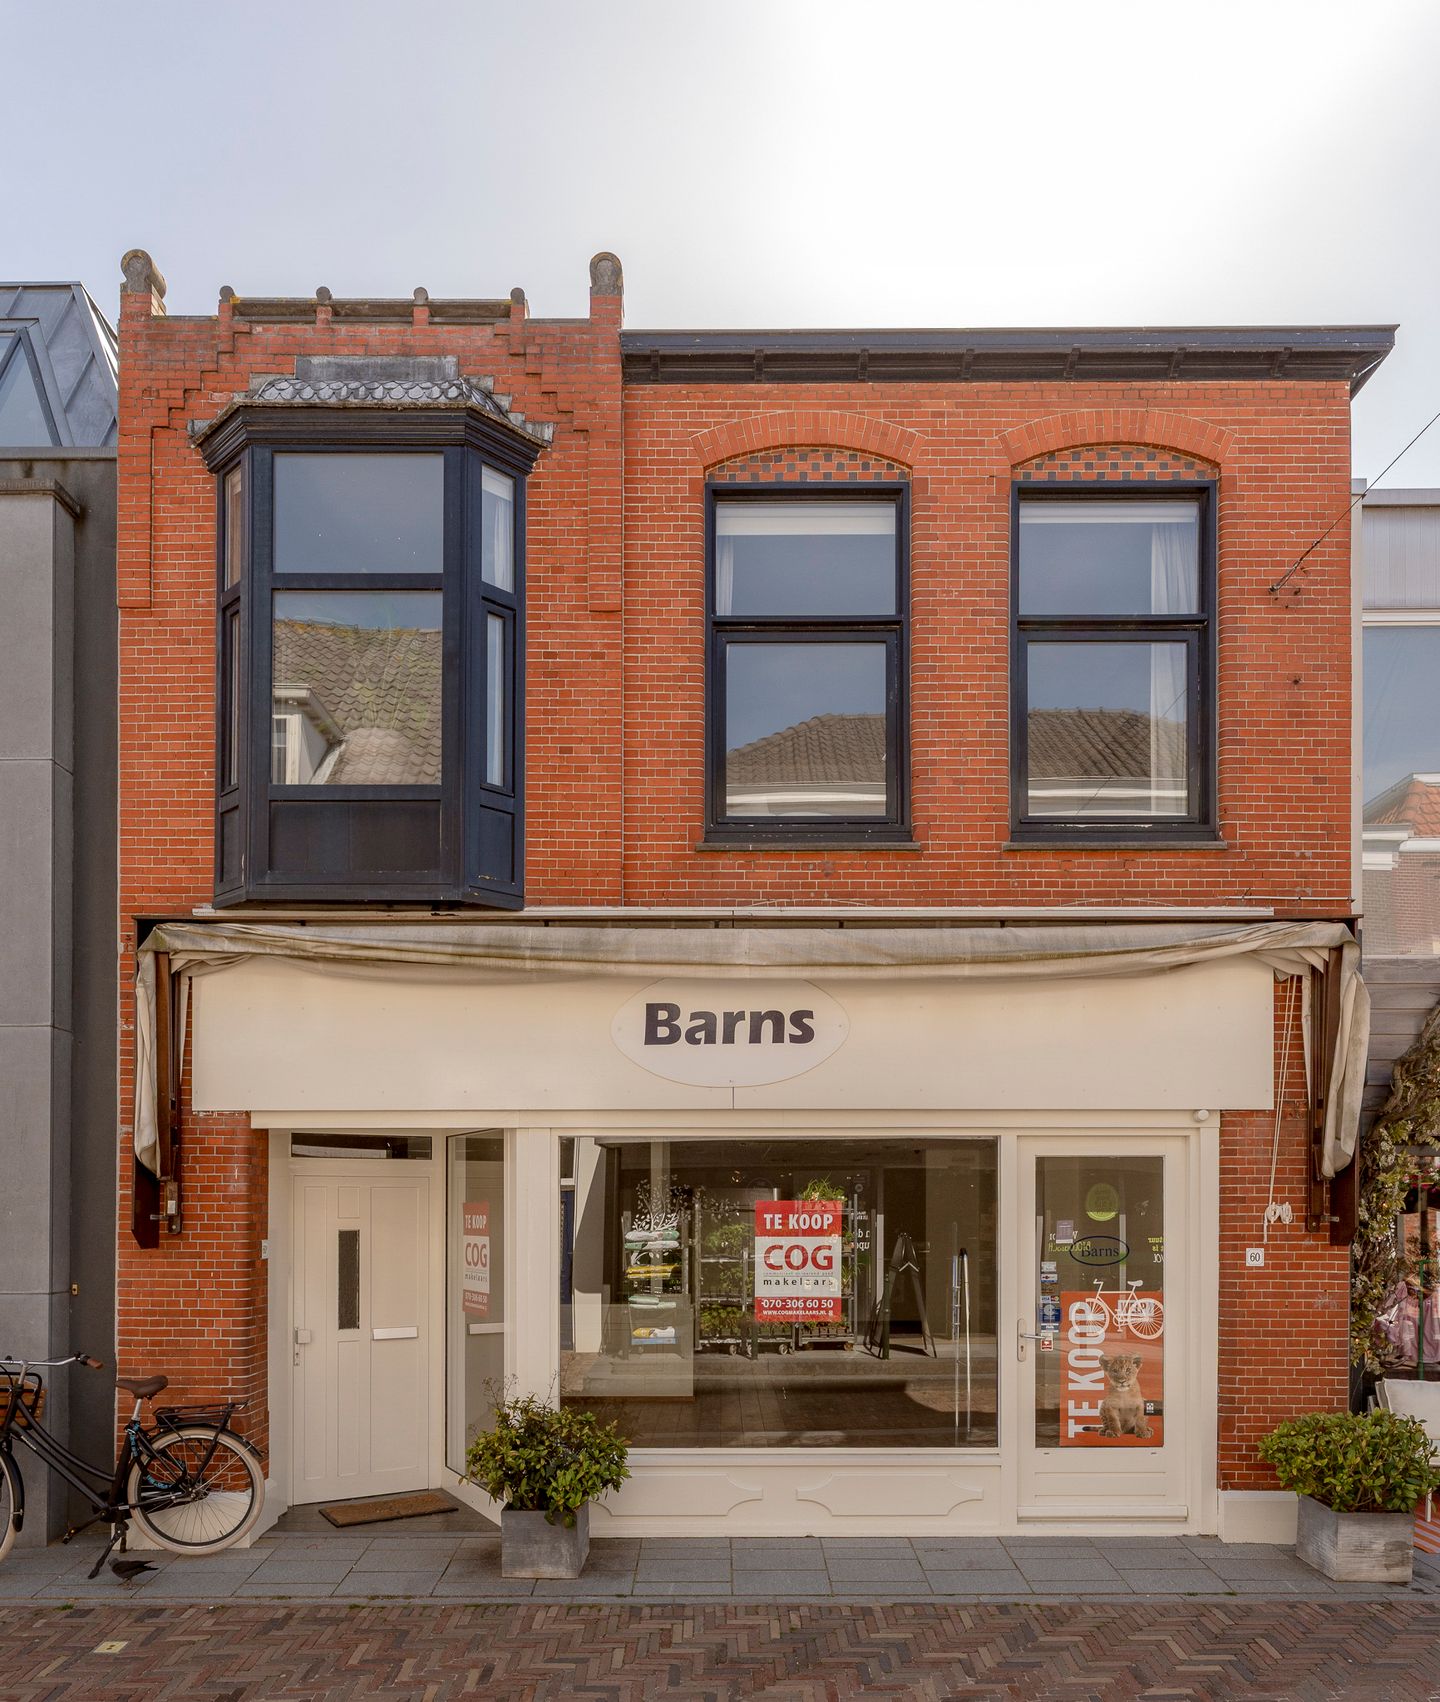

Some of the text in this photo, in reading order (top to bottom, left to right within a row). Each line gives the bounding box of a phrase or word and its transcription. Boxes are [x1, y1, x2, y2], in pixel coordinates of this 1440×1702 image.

[644, 1002, 815, 1045] Barns
[464, 1214, 487, 1230] TE KOOP
[763, 1213, 783, 1230] TE
[788, 1213, 833, 1230] KOOP
[465, 1242, 488, 1268] COG
[763, 1244, 834, 1271] COG
[1081, 1246, 1120, 1258] Barns
[1249, 1252, 1261, 1262] 60
[763, 1277, 834, 1286] makelaars
[763, 1299, 834, 1308] 070-306 60 50
[1067, 1301, 1106, 1439] TE KOOP
